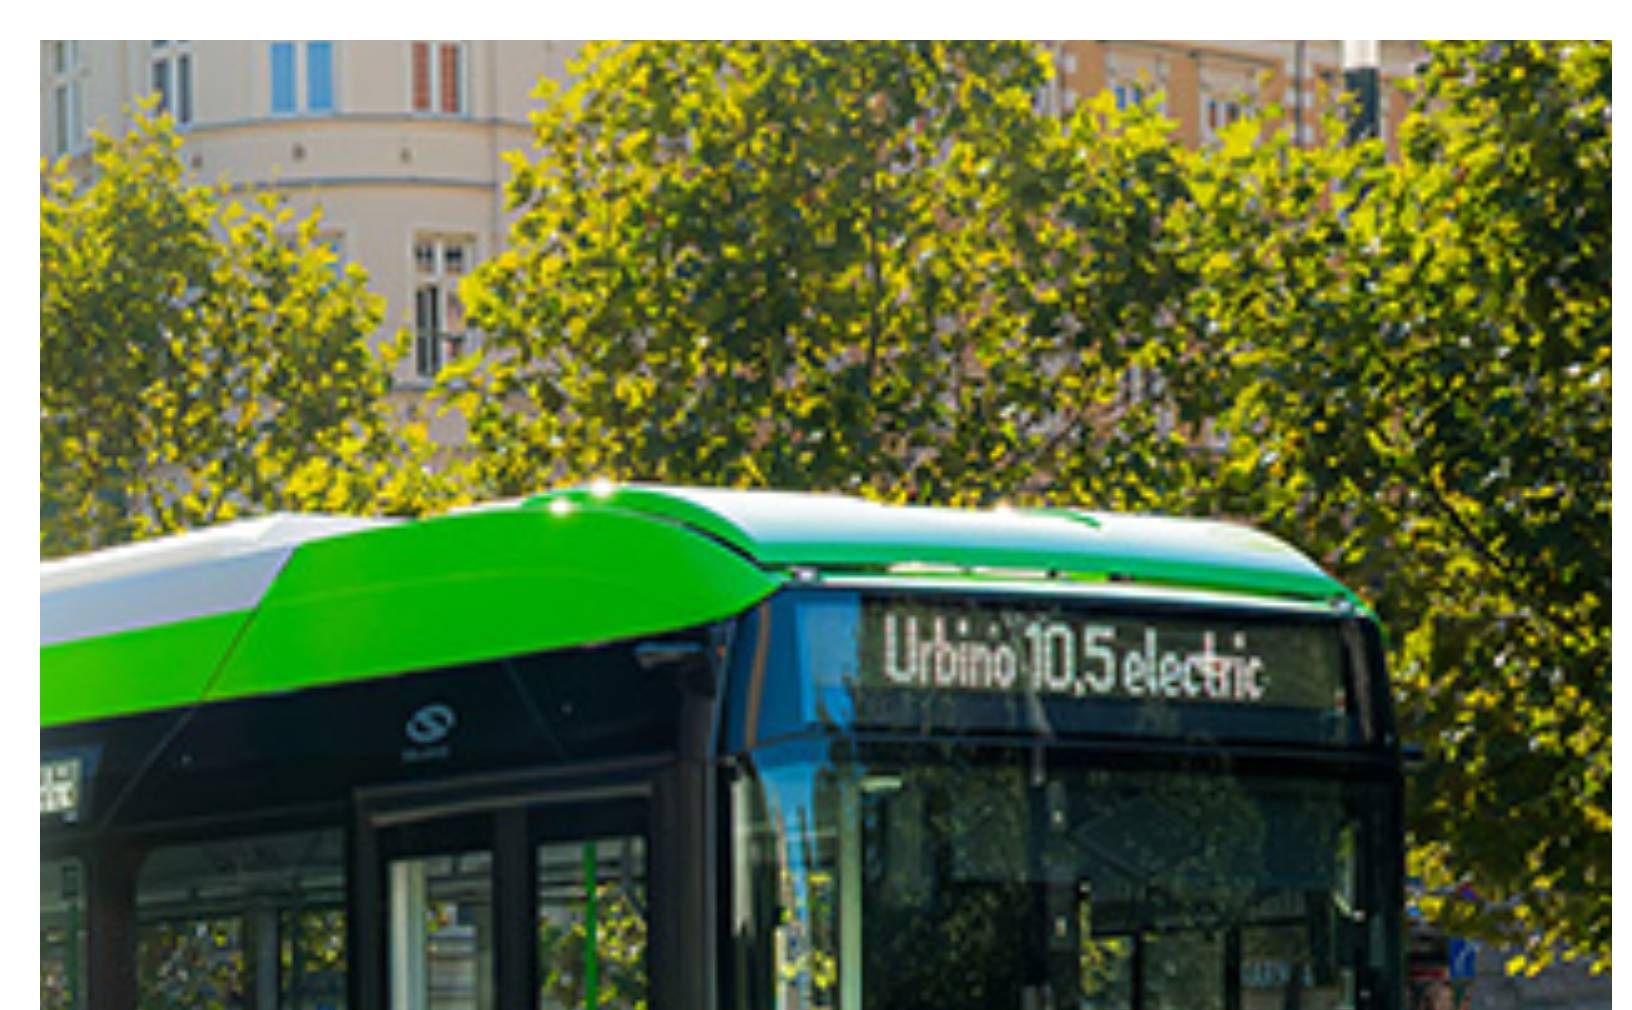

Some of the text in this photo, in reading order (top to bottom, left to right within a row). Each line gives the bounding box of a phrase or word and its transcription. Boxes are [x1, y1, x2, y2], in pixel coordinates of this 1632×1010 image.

[883, 612, 1266, 699] Urbino 10,5 electric
